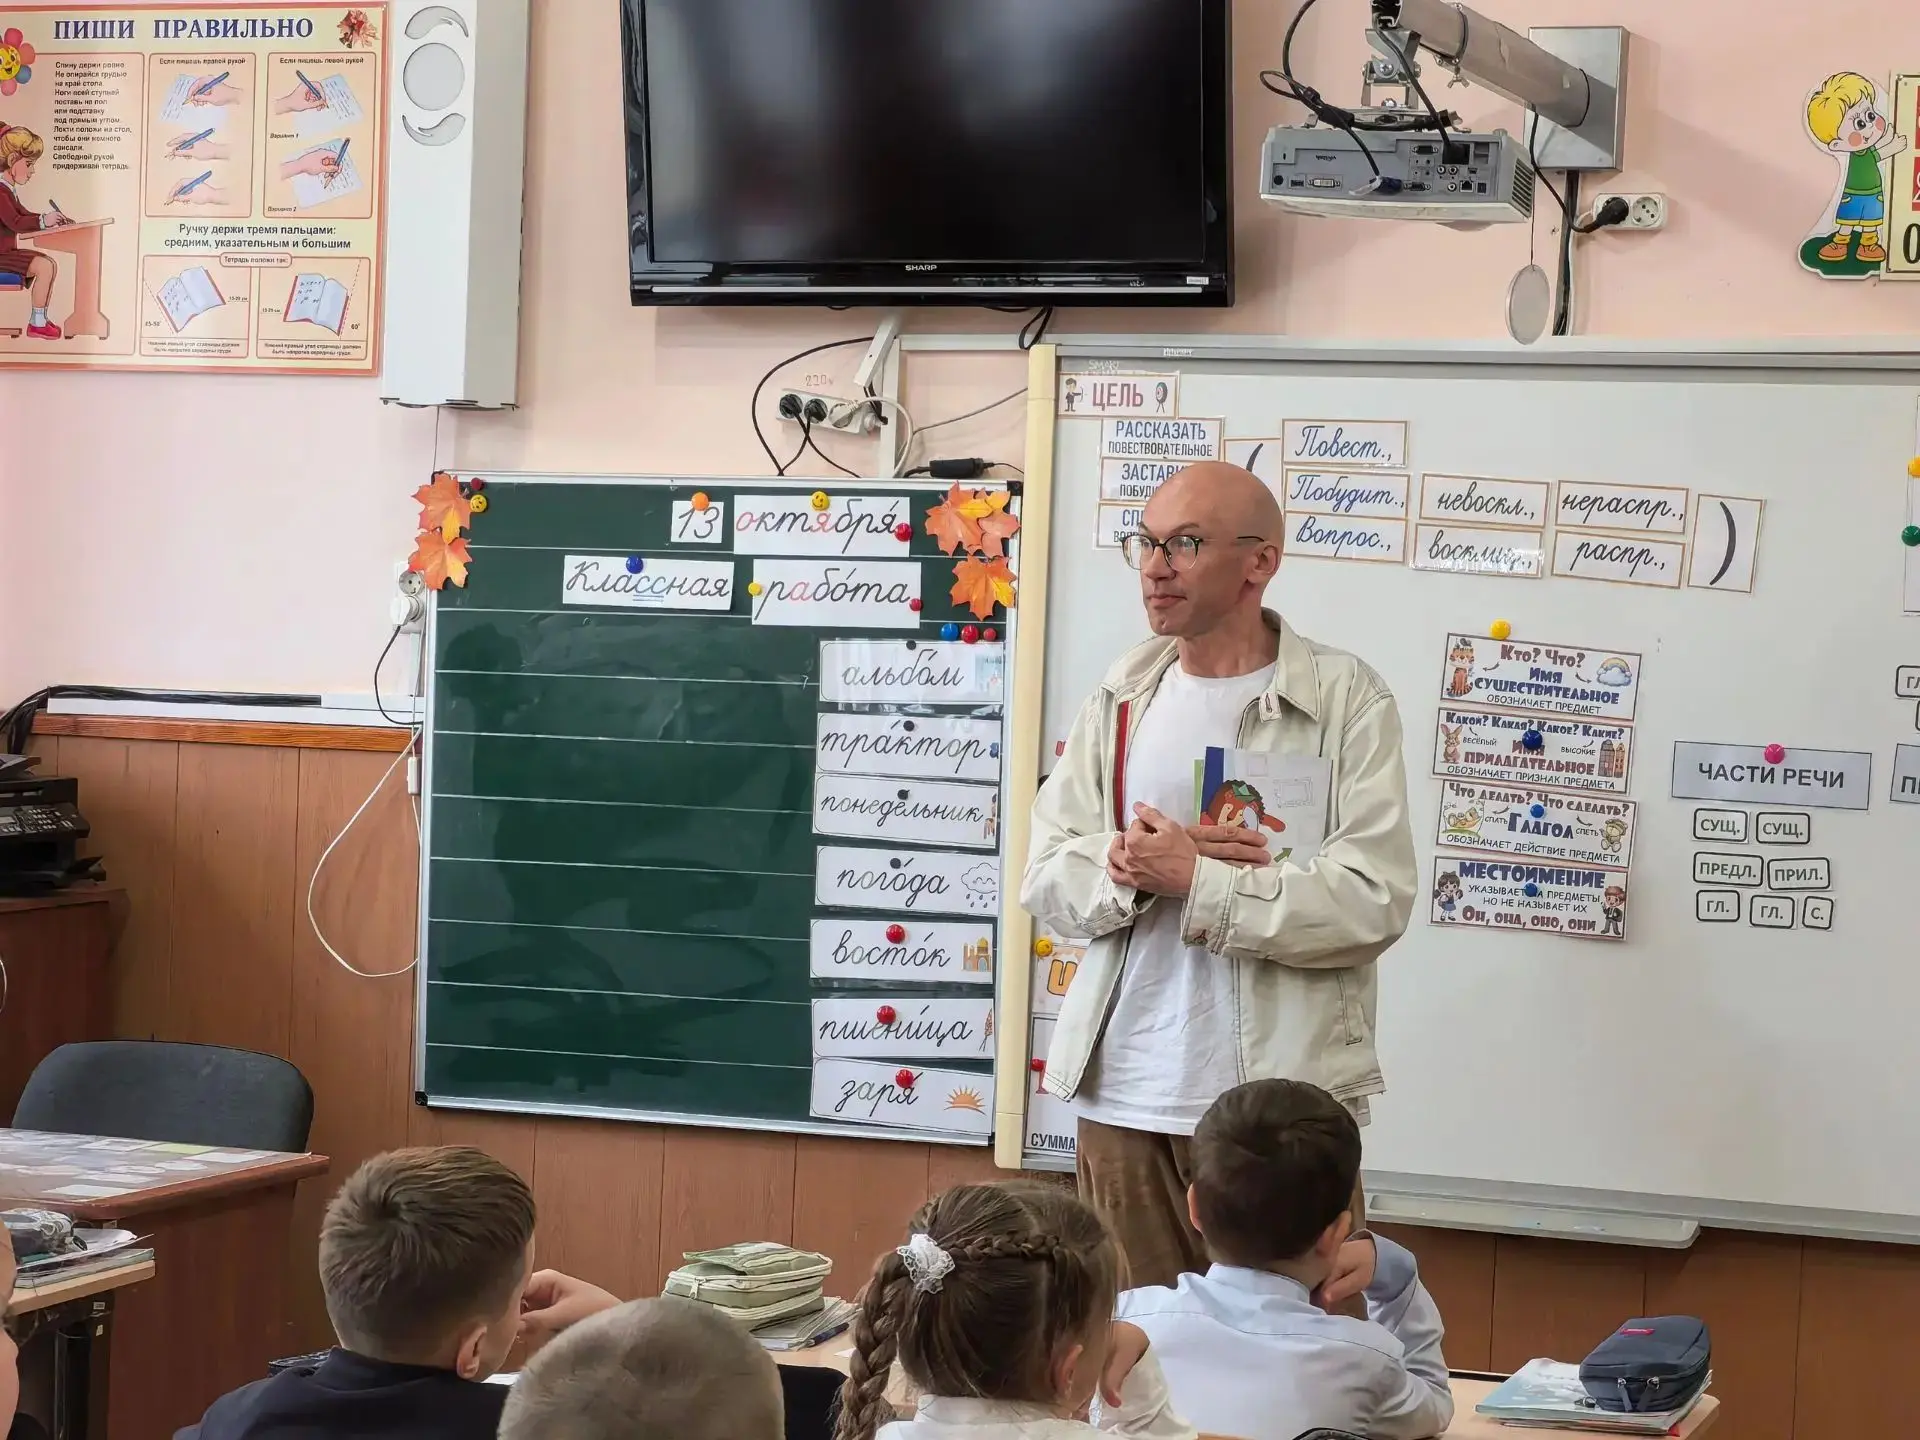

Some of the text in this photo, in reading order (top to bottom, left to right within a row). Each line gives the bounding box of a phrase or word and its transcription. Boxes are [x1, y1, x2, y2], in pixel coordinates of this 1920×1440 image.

[54, 18, 313, 39] ПИШИ ПРАВИЛЬНО
[179, 223, 336, 236] Ручку держи тремя пальцами:
[164, 238, 351, 249] средним, указательным и большим
[1092, 382, 1144, 411] ЦЕЛЬ
[1116, 420, 1206, 440] РАССКАЗАТЬ
[1108, 440, 1213, 457] ПОВЕСТВОВАТЕЛЬНОЕ
[1295, 425, 1392, 461] Повест.,
[1290, 474, 1404, 513] Побудит.,
[1437, 481, 1534, 520] невоскл.,
[1562, 493, 1684, 529] нераспр.,
[678, 506, 720, 539] 13
[1295, 515, 1391, 557] Вопрос.,
[1570, 541, 1665, 578] распр.,
[565, 561, 730, 595] Классная
[1486, 693, 1602, 715] ОБОЗНАЧАЕТ ПРЕДМЕТ
[1560, 746, 1596, 756] ВЫСОКИЕ
[1464, 751, 1595, 775] ПРИЛАГАТЕЛЬНОЕ
[1447, 765, 1615, 790] ОБОЗНАЧАЕТ ПРИЗНАК ПРЕДМЕТА
[1698, 762, 1844, 789] ЧАСТИ РЕЧИ
[1700, 818, 1740, 835] СУЩ.
[1762, 822, 1804, 838] СУЩ.
[1446, 834, 1620, 864] ОБОЗНАЧАЕТ ДЕЙСТВИЕ ПРЕДМЕТА
[1459, 861, 1606, 889] МЕСТОИМЕНИЕ
[1699, 861, 1757, 880] ПРЕДЛ.
[1774, 867, 1824, 882] ПРИЛ.
[1468, 884, 1526, 897] УКАЗЫВАЕТ
[1547, 890, 1604, 905] ПРЕДМЕТЫ,
[1483, 896, 1588, 913] НО НЕ НАЗЫВАЕТ ИХ
[1706, 900, 1730, 913] ГЛ.
[1760, 905, 1784, 920] ГЛ.
[1810, 906, 1824, 920] С.
[1030, 1132, 1076, 1151] СУММА
